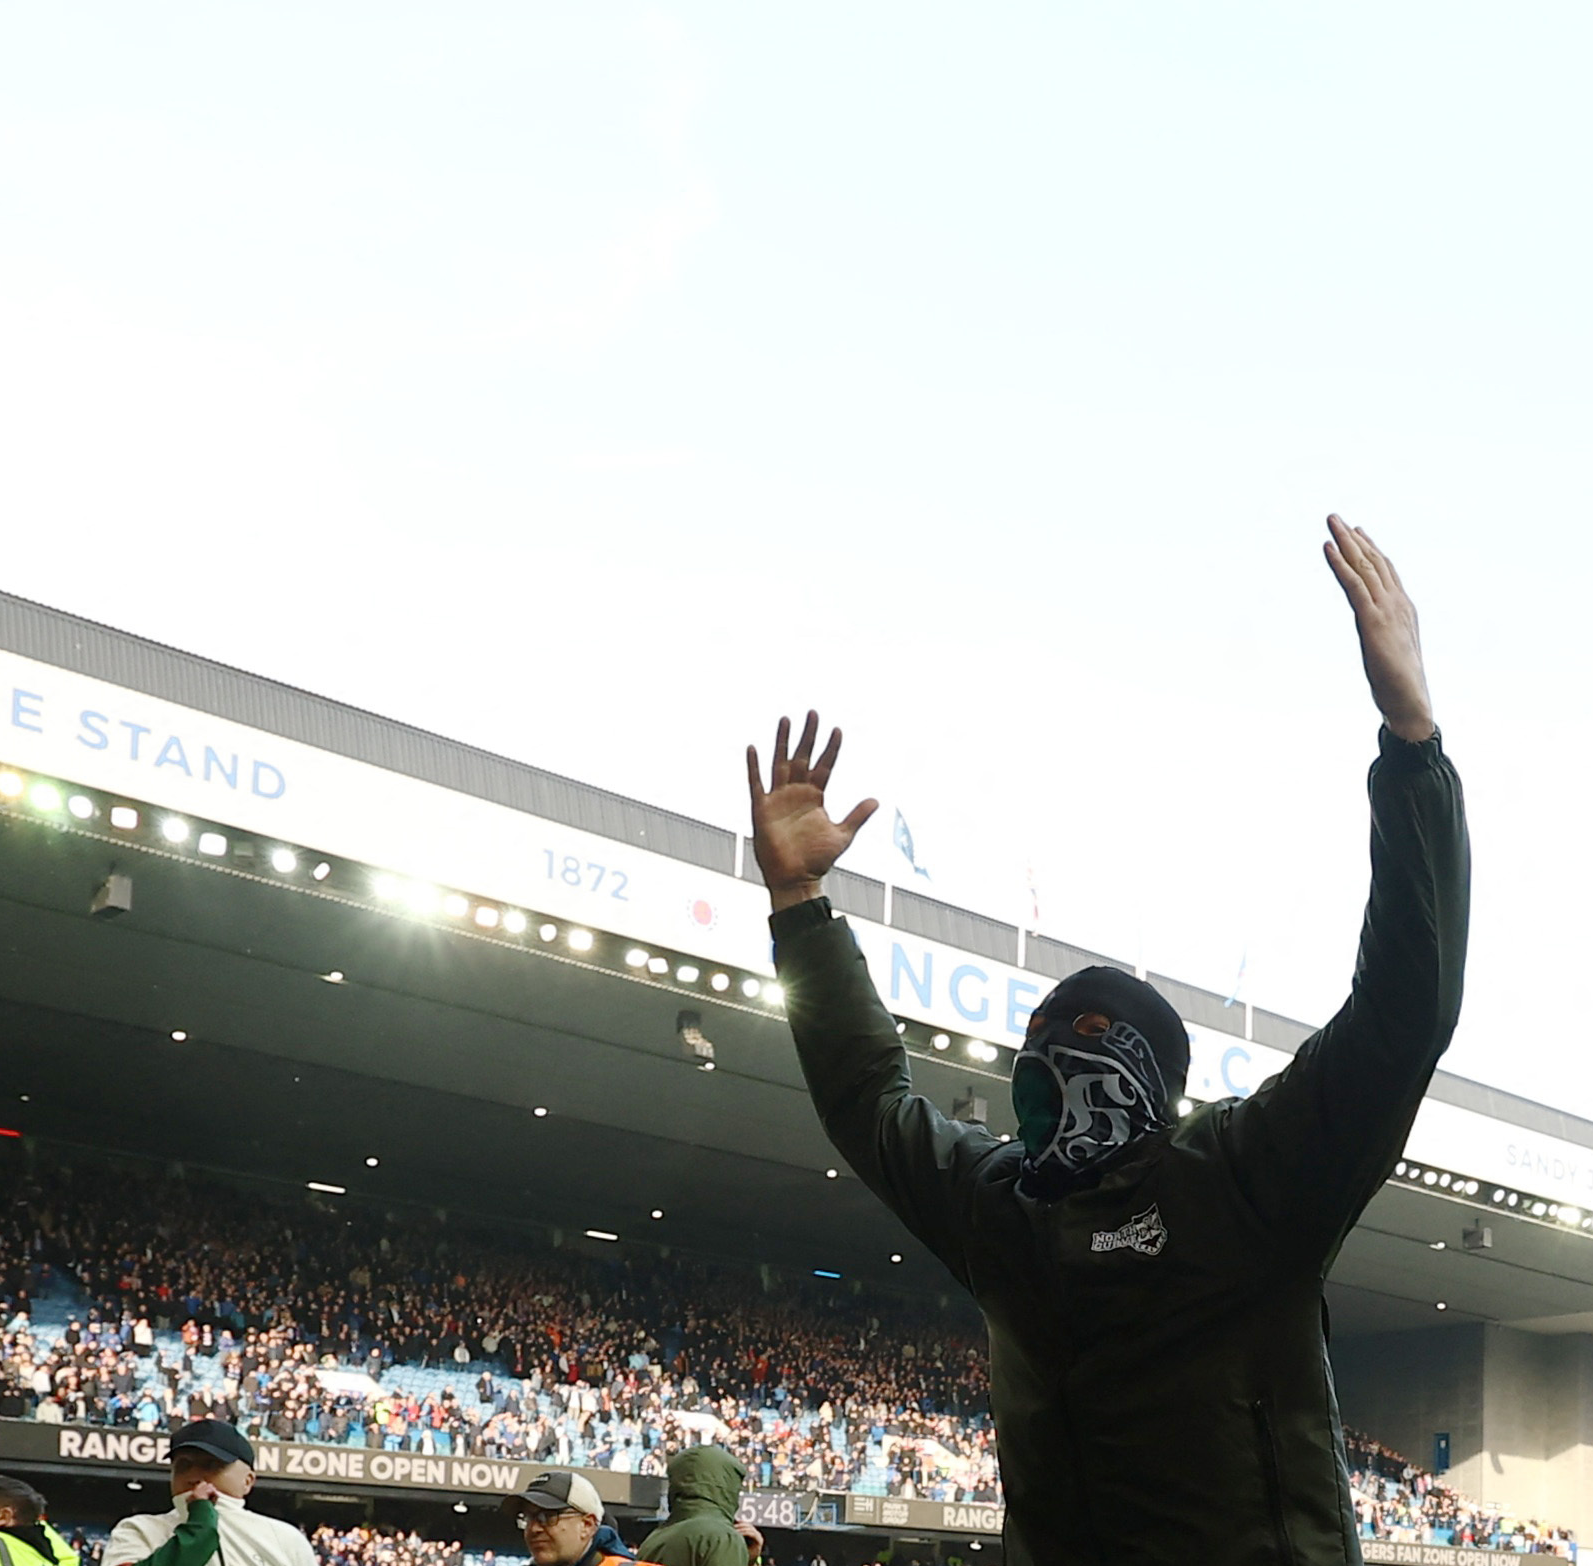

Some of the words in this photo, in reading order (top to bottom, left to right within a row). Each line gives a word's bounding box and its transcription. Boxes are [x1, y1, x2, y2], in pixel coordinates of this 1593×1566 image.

[76, 709, 287, 801] STAND
[543, 848, 629, 901] 1872
[1507, 1143, 1577, 1185] SANDY
[59, 1430, 172, 1464] RANGE
[286, 1449, 364, 1479] ZONE
[370, 1457, 456, 1485] OPEN
[461, 1464, 520, 1490] NOW
[942, 1506, 1004, 1531] RANGE
[1362, 1544, 1395, 1561] GERS
[1397, 1548, 1422, 1564] FAN
[1423, 1550, 1456, 1566] ZONE
